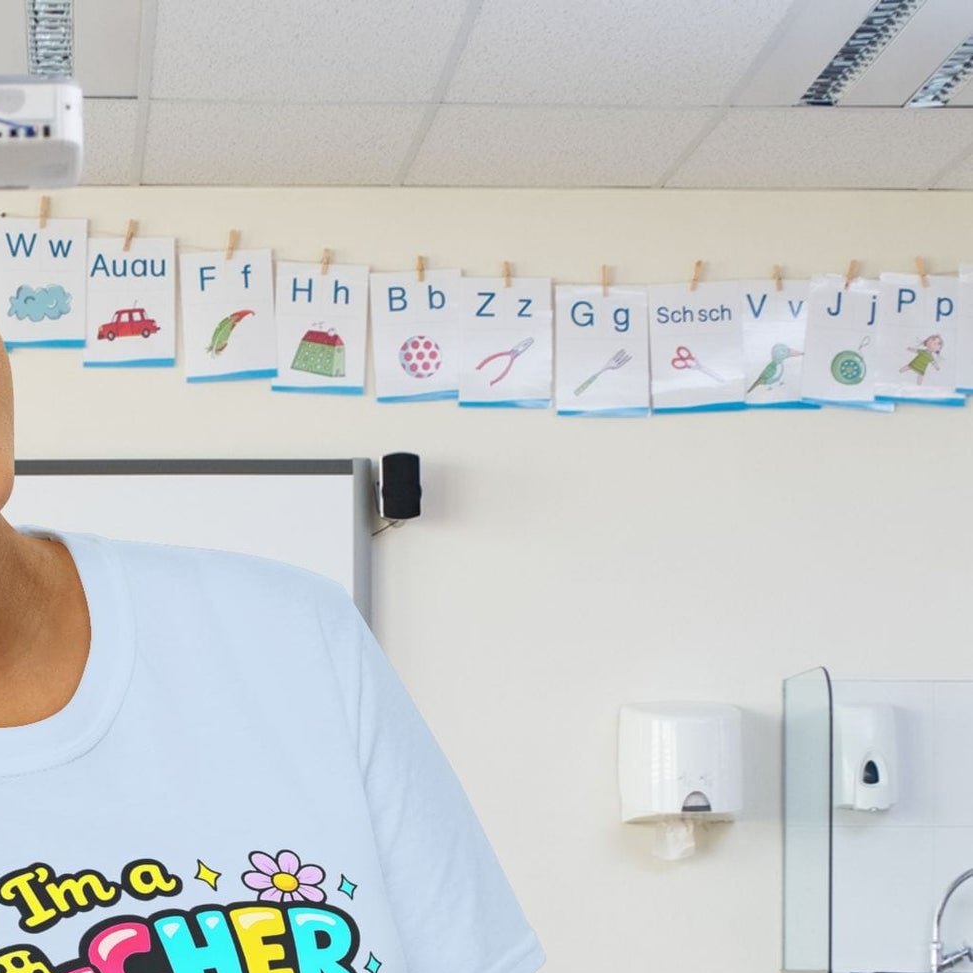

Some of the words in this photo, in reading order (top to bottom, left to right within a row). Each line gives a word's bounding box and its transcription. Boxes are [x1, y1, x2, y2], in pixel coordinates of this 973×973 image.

[5, 232, 37, 258] W
[48, 239, 73, 258] w
[198, 266, 217, 291] F
[241, 264, 252, 289] f
[291, 278, 314, 303] H
[333, 280, 350, 304] h
[387, 287, 409, 312] B
[427, 284, 446, 311] b
[475, 291, 496, 318] Z
[517, 298, 533, 318] z
[746, 293, 767, 318] V
[788, 300, 804, 318] v
[827, 291, 842, 316] J
[867, 295, 877, 326] j
[897, 288, 917, 313] P
[935, 297, 954, 322] p
[570, 301, 595, 327] G
[612, 307, 631, 333] g
[656, 306, 694, 324] Sch
[698, 304, 732, 322] sch
[0, 867, 115, 927] I'm
[129, 864, 176, 894] a
